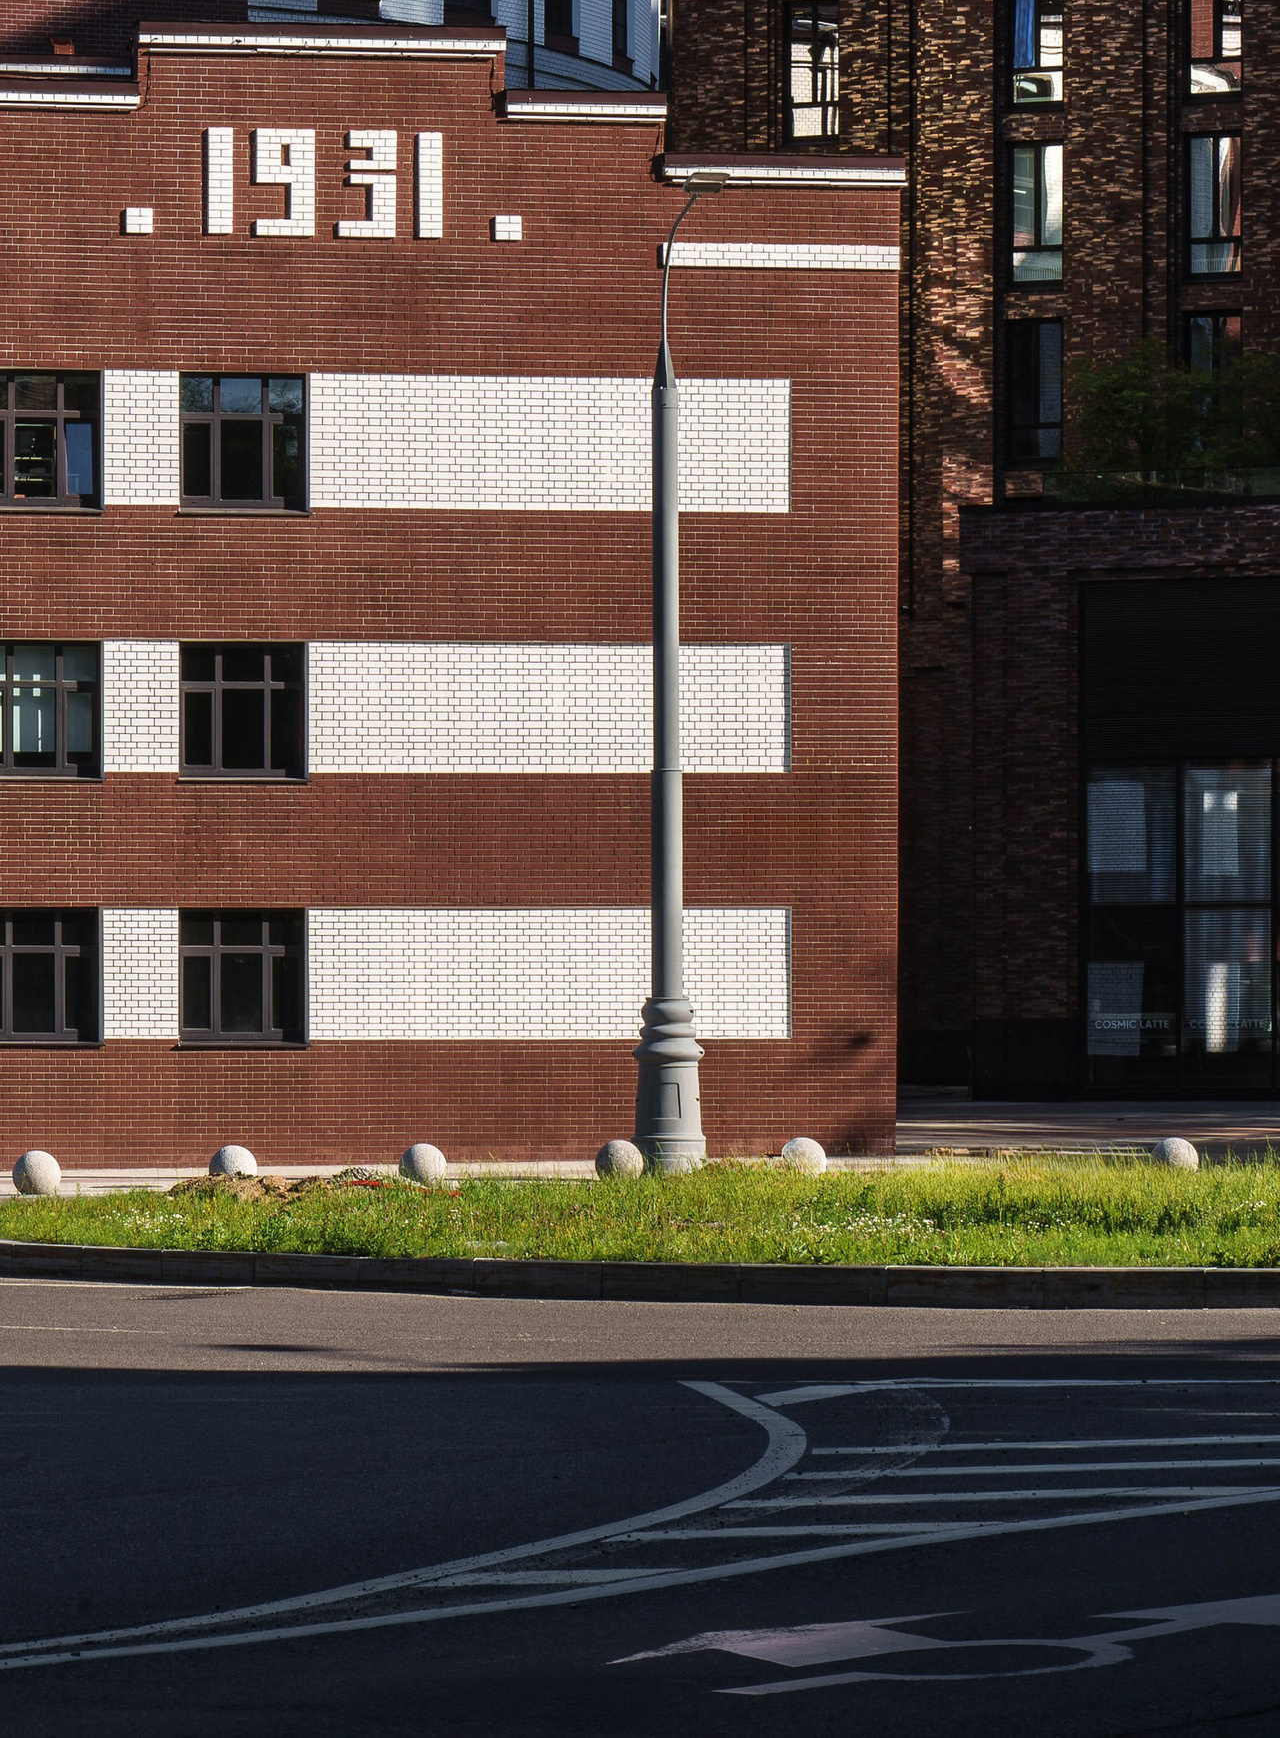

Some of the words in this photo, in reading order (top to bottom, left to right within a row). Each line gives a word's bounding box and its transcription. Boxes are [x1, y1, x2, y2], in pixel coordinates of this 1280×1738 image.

[206, 127, 443, 239] 1931
[1094, 1019, 1137, 1030] COSMIC
[1139, 1019, 1170, 1029] LATTE
